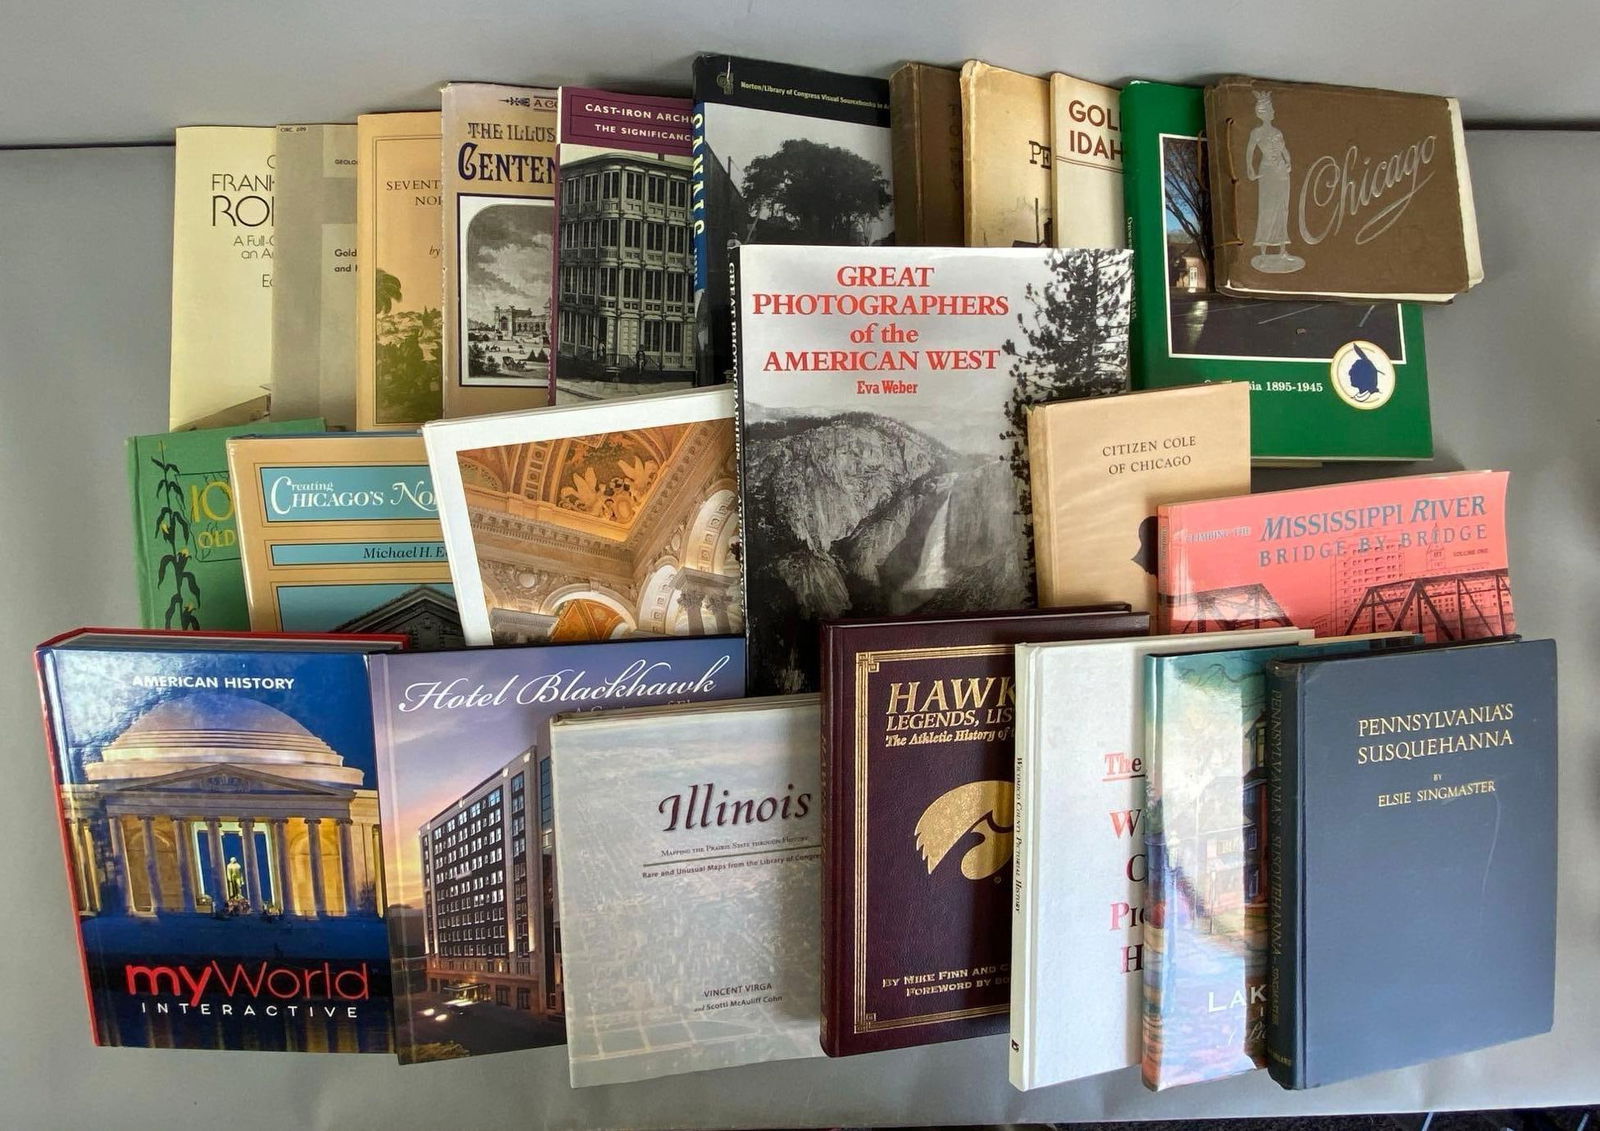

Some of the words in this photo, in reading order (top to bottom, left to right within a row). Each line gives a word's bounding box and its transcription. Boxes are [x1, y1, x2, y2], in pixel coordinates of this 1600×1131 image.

[741, 81, 785, 95] Norton/Library
[793, 90, 820, 100] Congress
[821, 94, 839, 103] Visual
[585, 103, 651, 119] CAST-IRON
[468, 122, 503, 140] THE
[507, 125, 555, 142] ILLUS
[595, 123, 616, 134] THE
[386, 180, 441, 191] SEVENT
[1299, 136, 1437, 245] Chicago
[233, 236, 244, 247] A
[241, 250, 258, 259] an
[334, 249, 357, 258] Gold
[429, 246, 441, 258] by
[334, 264, 351, 273] and
[837, 266, 935, 287] GREAT
[752, 293, 1009, 316] PHOTOGRAPHERS
[850, 323, 878, 343] of
[881, 323, 919, 343] the
[763, 351, 920, 372] AMERICAN
[926, 350, 1000, 370] WEST
[857, 380, 880, 394] Eva
[882, 380, 918, 394] Weber
[1266, 382, 1323, 393] 1895-1945
[1102, 440, 1157, 457] CITIZEN
[1164, 435, 1196, 450] COLE
[1109, 464, 1126, 475] OF
[1131, 454, 1192, 472] CHICAGO
[1260, 503, 1403, 542] MISSISSIPPI
[1410, 495, 1487, 523] RIVER
[198, 529, 235, 549] OLD
[1260, 540, 1346, 567] BRIDGE
[1360, 535, 1388, 554] BY
[1400, 523, 1487, 549] BRIDGE
[363, 547, 416, 559] Michael
[419, 547, 432, 559] H.
[132, 675, 218, 689] AMERICAN
[224, 677, 295, 690] HISTORY
[399, 674, 519, 712] Hotel
[516, 655, 730, 705] Blackhawk
[886, 710, 980, 731] LEGENDS,
[1358, 703, 1513, 737] PENNSYLVANIA'S
[886, 735, 906, 747] The
[909, 731, 953, 745] Athletic
[954, 729, 995, 742] History
[997, 727, 1010, 740] of
[1358, 729, 1513, 765] SUSQUEHANNA
[1105, 752, 1142, 775] The
[1378, 792, 1411, 807] ELSIE
[1416, 780, 1495, 801] SINGMASTER
[658, 783, 811, 831] Illinois
[642, 871, 659, 879] Rare
[661, 869, 674, 877] and
[676, 866, 705, 875] Unusual
[707, 863, 726, 873] Maps
[728, 861, 744, 869] from
[746, 859, 758, 867] the
[760, 856, 784, 867] Library
[125, 960, 369, 1007] myWorld
[882, 977, 900, 988] BY
[904, 973, 935, 985] MIKE
[939, 969, 968, 980] FINN
[972, 966, 997, 976] AND
[704, 986, 742, 998] VINCENT
[745, 983, 772, 992] VIRGA
[906, 981, 972, 997] FOREWORD
[976, 979, 991, 988] BY
[694, 1004, 705, 1012] and
[706, 1001, 728, 1011] Scotti
[730, 997, 762, 1006] McAuliff
[763, 995, 783, 1004] Cohn
[1208, 984, 1267, 1013] LAK
[142, 1003, 357, 1018] INTERACTIVE
